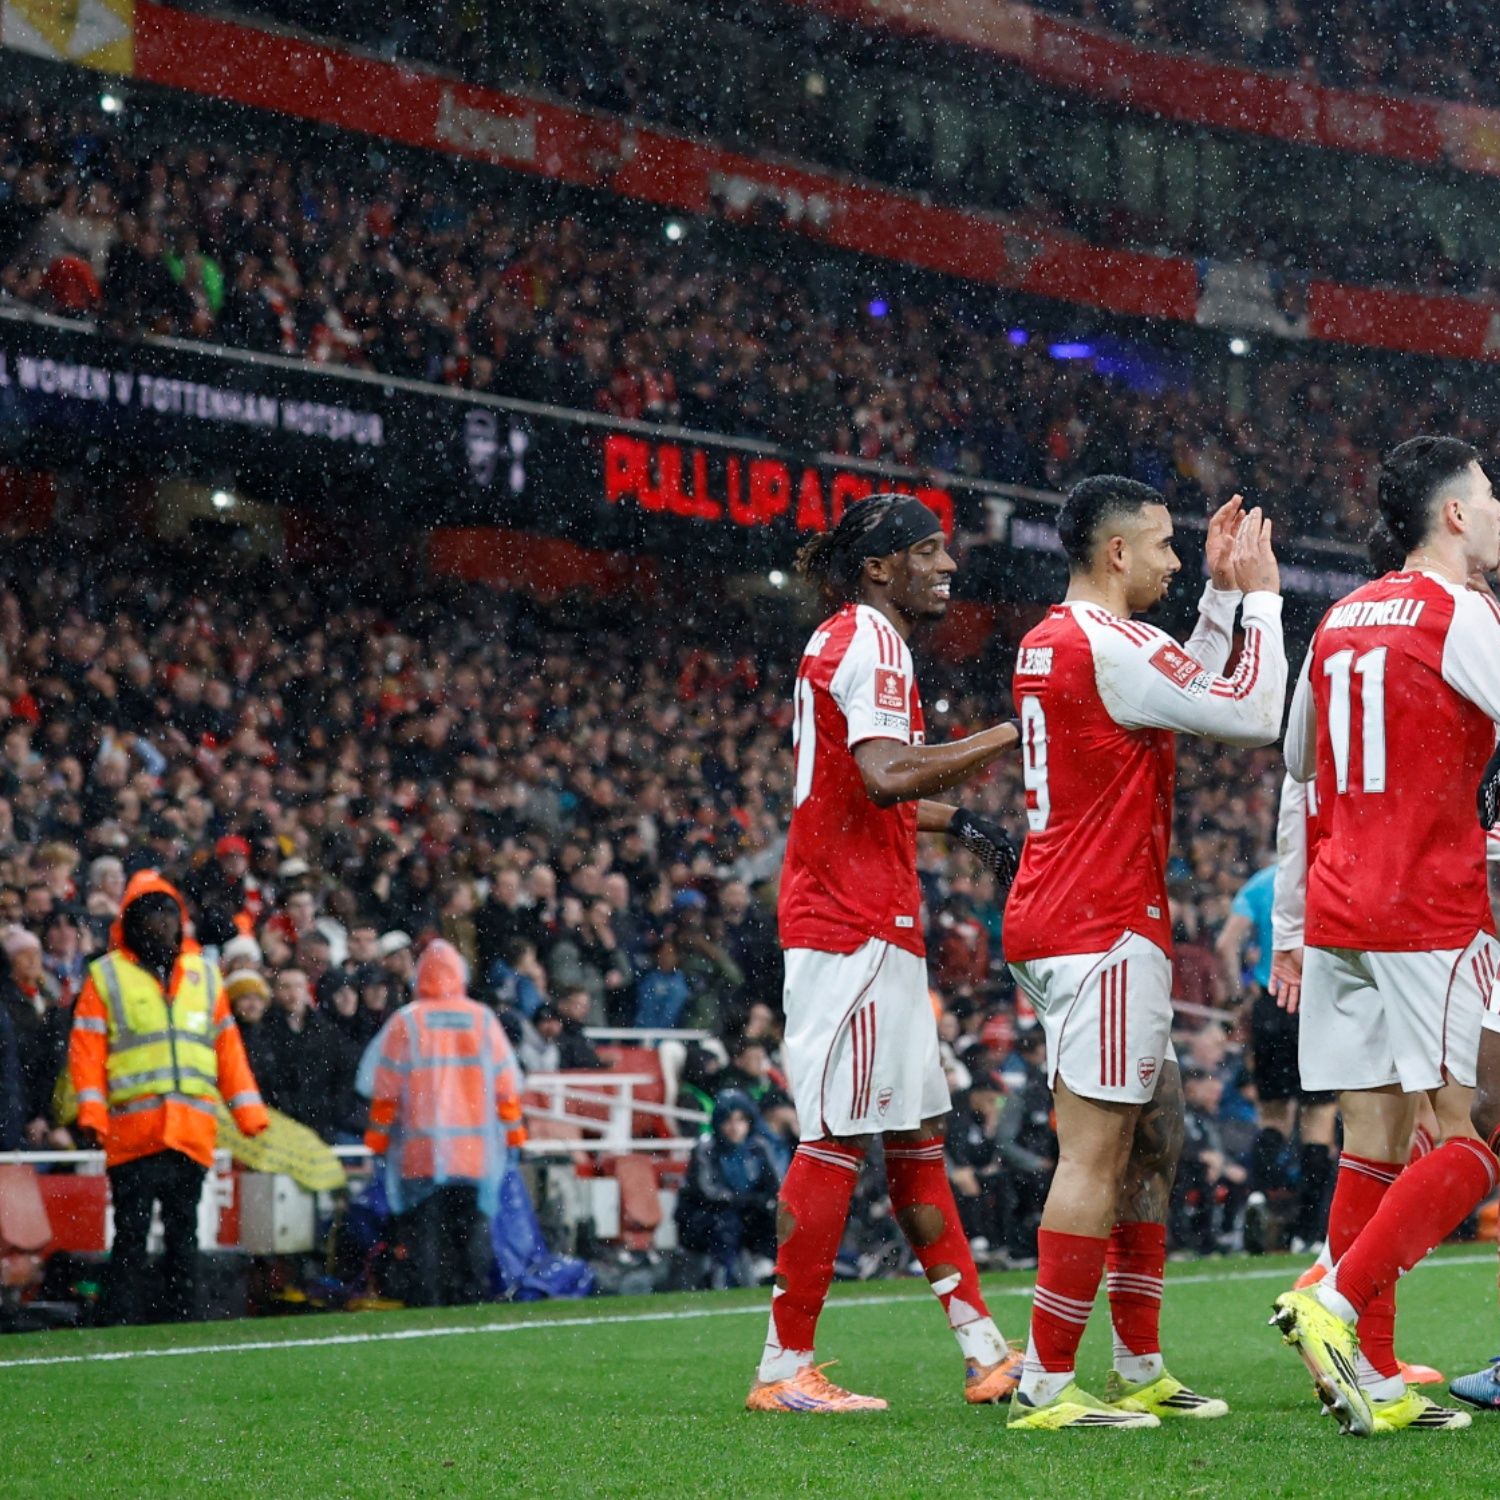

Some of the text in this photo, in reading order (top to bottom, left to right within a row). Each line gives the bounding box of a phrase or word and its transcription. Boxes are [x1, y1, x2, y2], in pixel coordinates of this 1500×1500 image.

[17, 356, 109, 400] WOMEN
[115, 372, 134, 405] V
[138, 373, 278, 428] TOTTENHAM
[282, 400, 385, 446] HOTSPUR
[604, 434, 721, 520] PULL
[727, 455, 790, 526] UP
[1323, 597, 1425, 632] MARTINELLI
[1021, 695, 1051, 831] 9
[1323, 646, 1387, 794] 11
